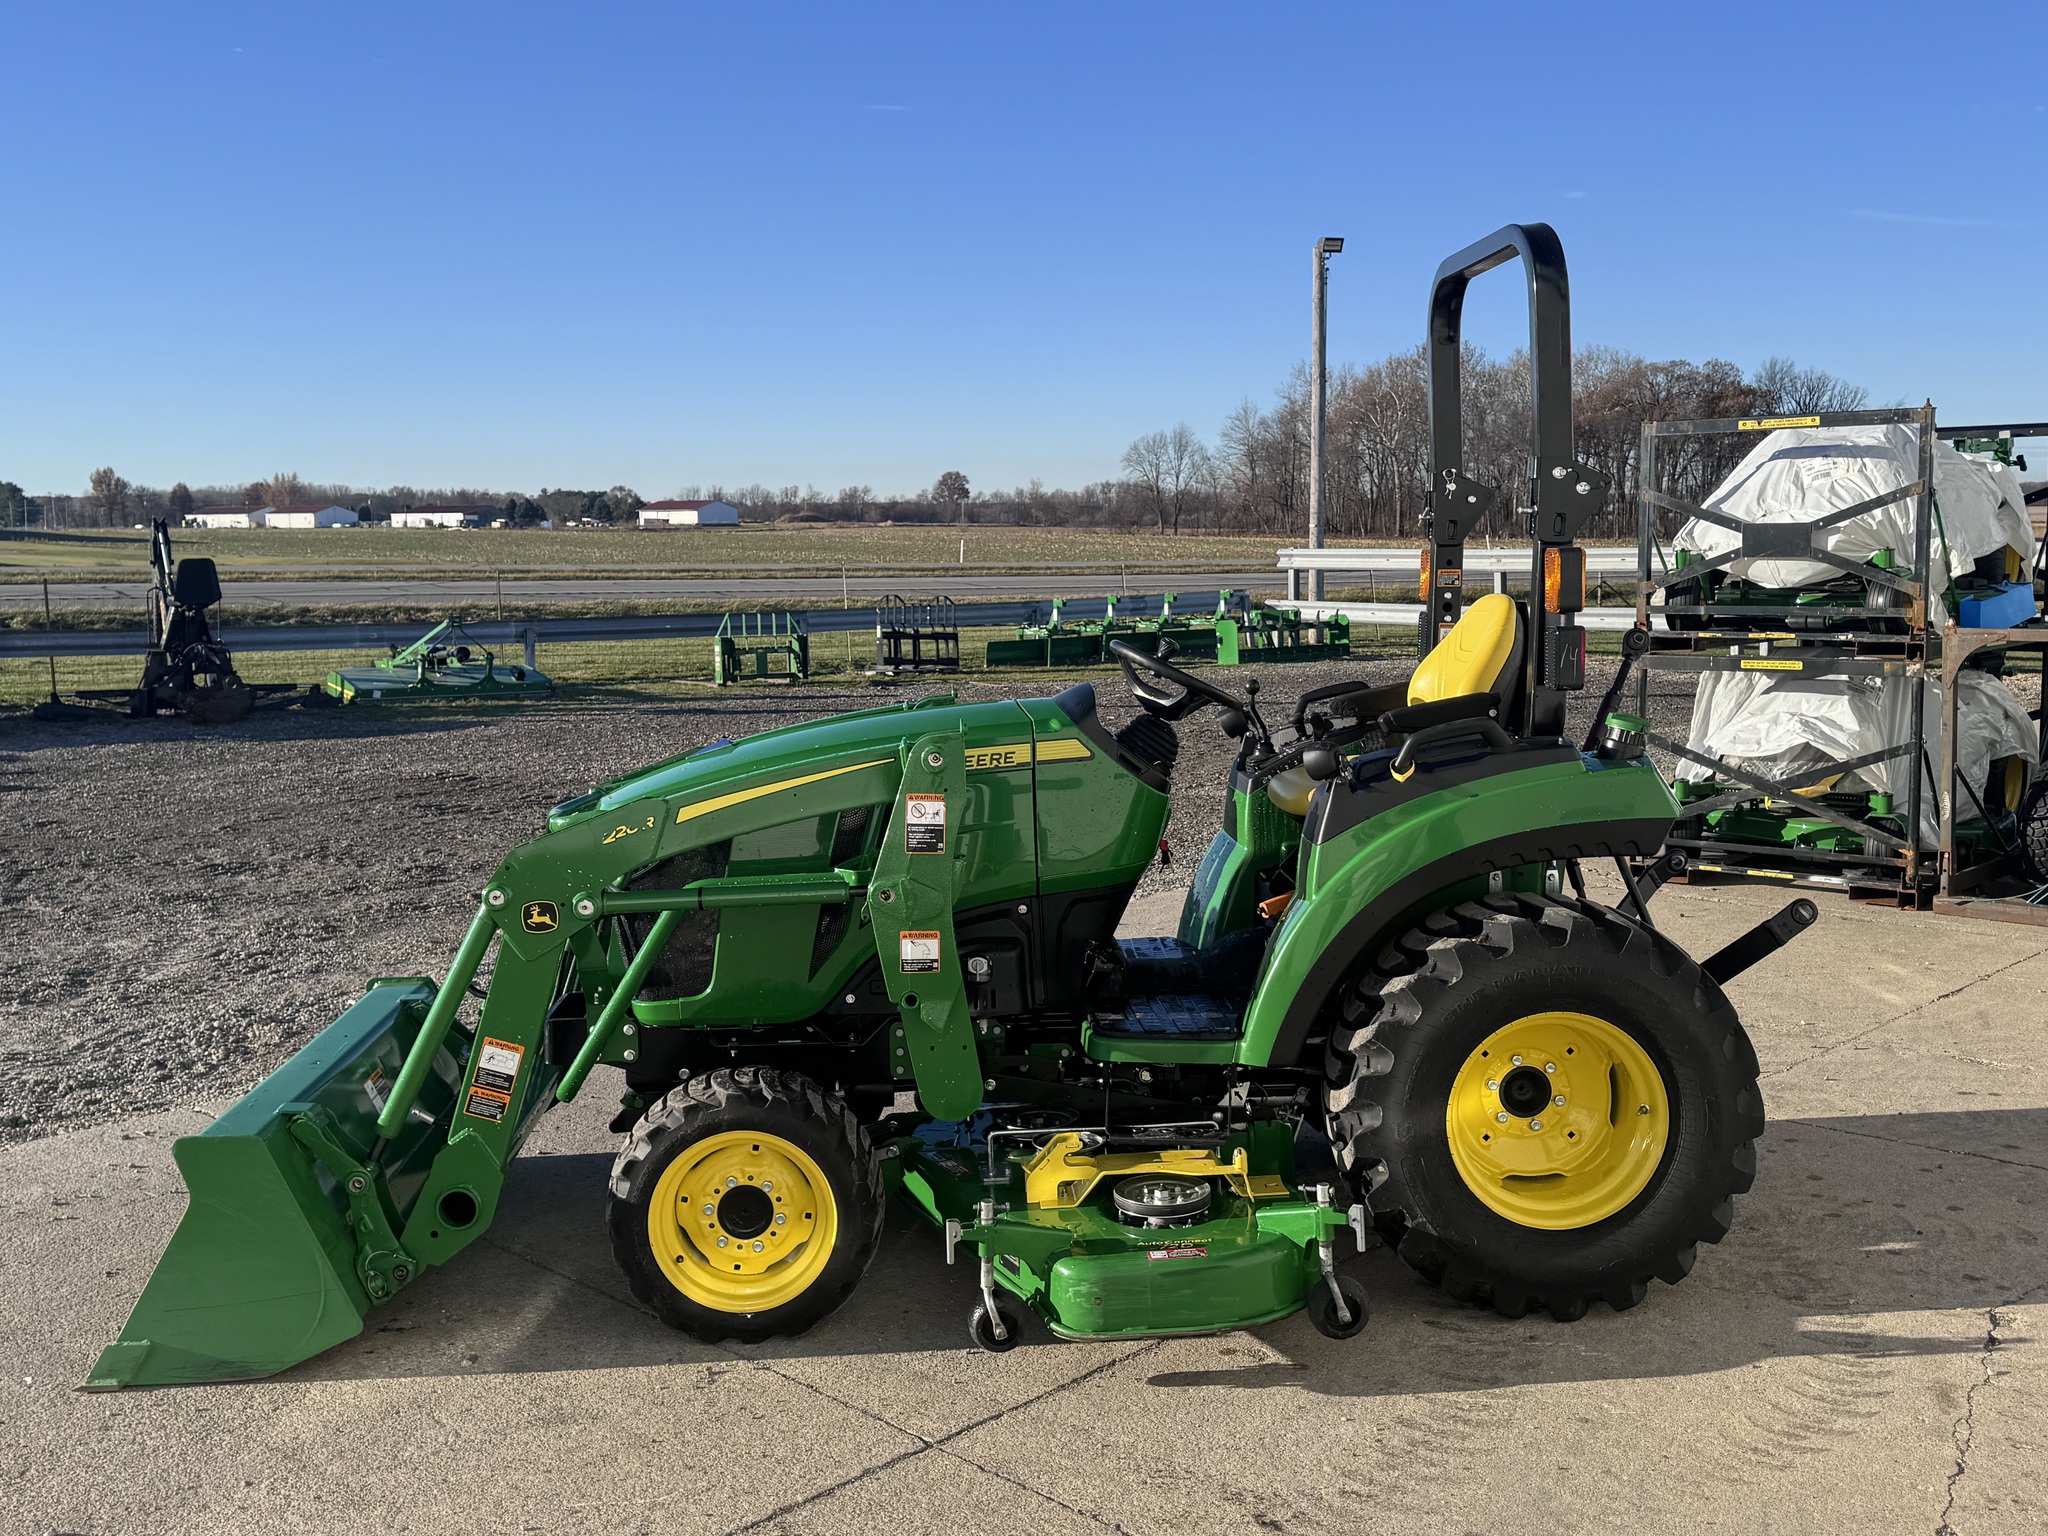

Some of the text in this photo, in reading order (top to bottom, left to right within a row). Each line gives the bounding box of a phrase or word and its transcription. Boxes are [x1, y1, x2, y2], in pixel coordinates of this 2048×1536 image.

[965, 751, 1016, 767] EERE
[494, 1042, 520, 1051] WARNING
[480, 1090, 506, 1101] WARNING
